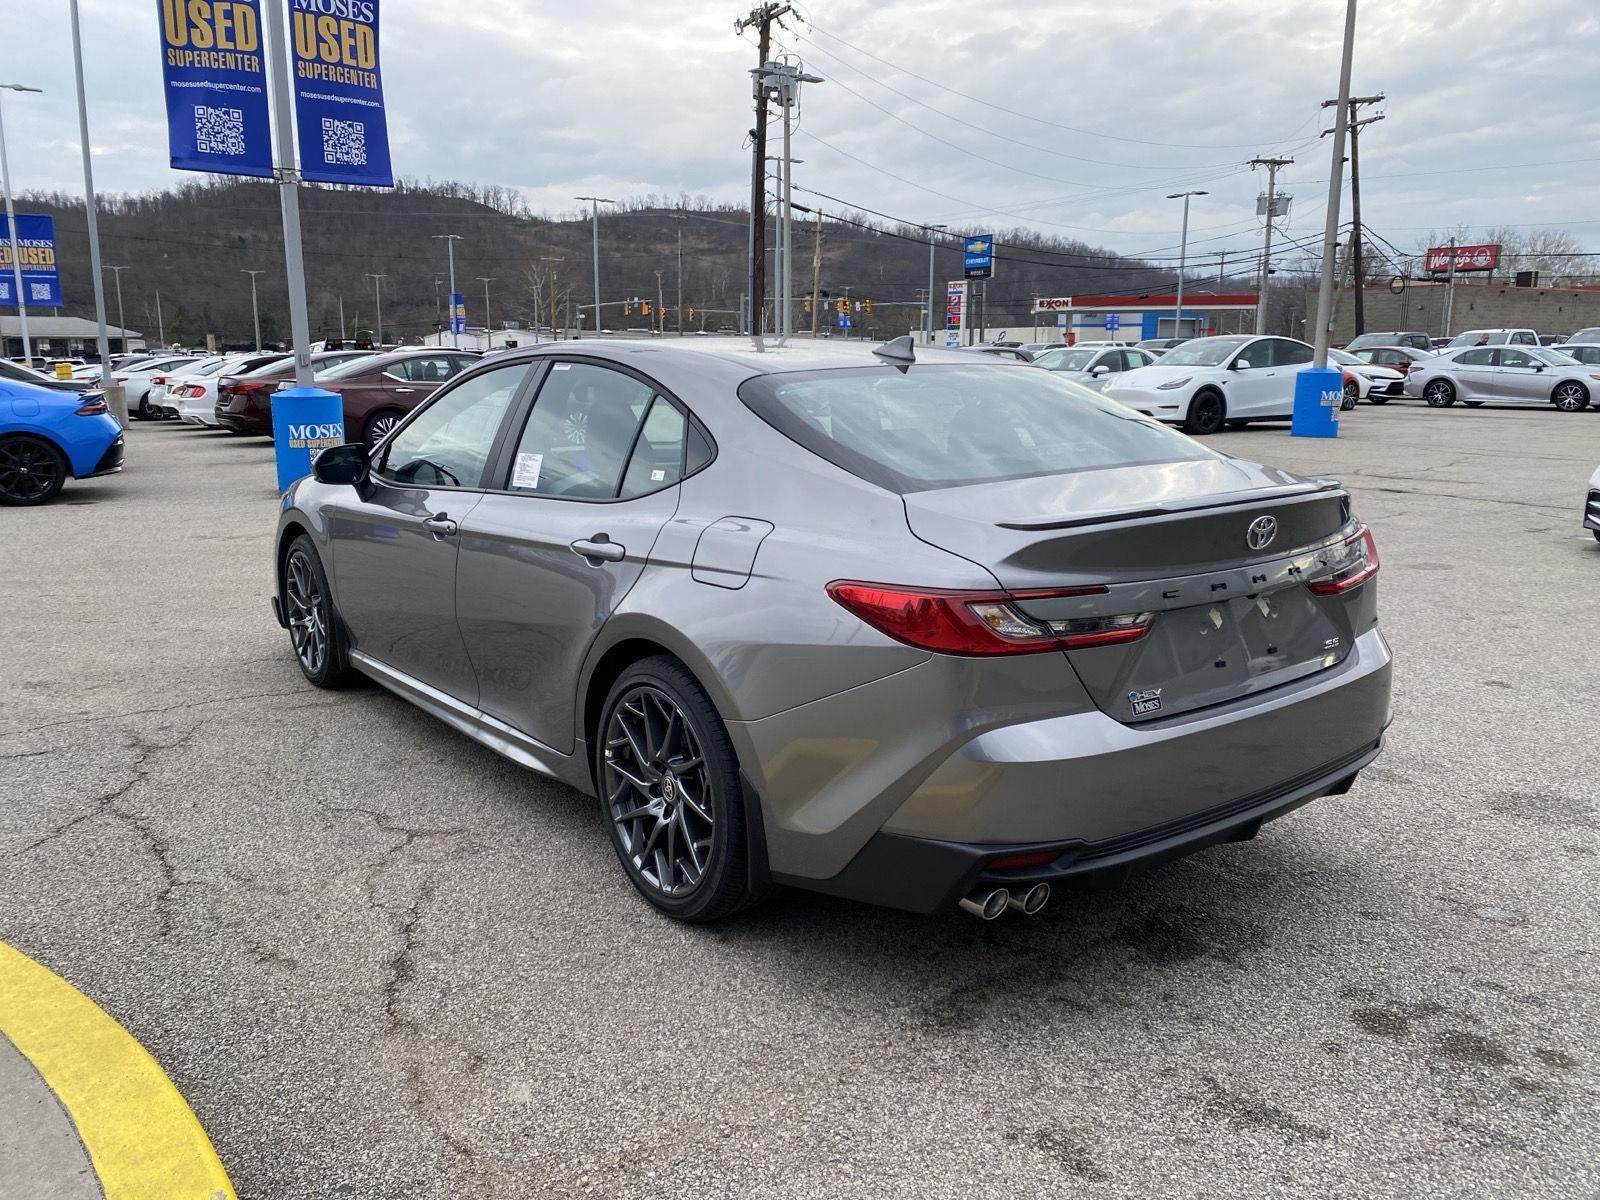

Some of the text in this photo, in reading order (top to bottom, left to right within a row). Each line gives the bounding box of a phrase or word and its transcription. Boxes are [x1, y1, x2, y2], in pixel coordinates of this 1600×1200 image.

[163, 0, 258, 52] USED
[293, 11, 376, 70] USED
[167, 48, 260, 73] SUPERCENTER
[297, 60, 378, 89] SUPERCENTER
[170, 80, 262, 93] mosesusedsupercenter.com
[300, 90, 381, 108] mosesusedsupercenter.com
[17, 239, 53, 247] MOSES
[18, 247, 55, 264] USED
[1039, 298, 1069, 310] EXXON
[288, 423, 343, 440] MOSES
